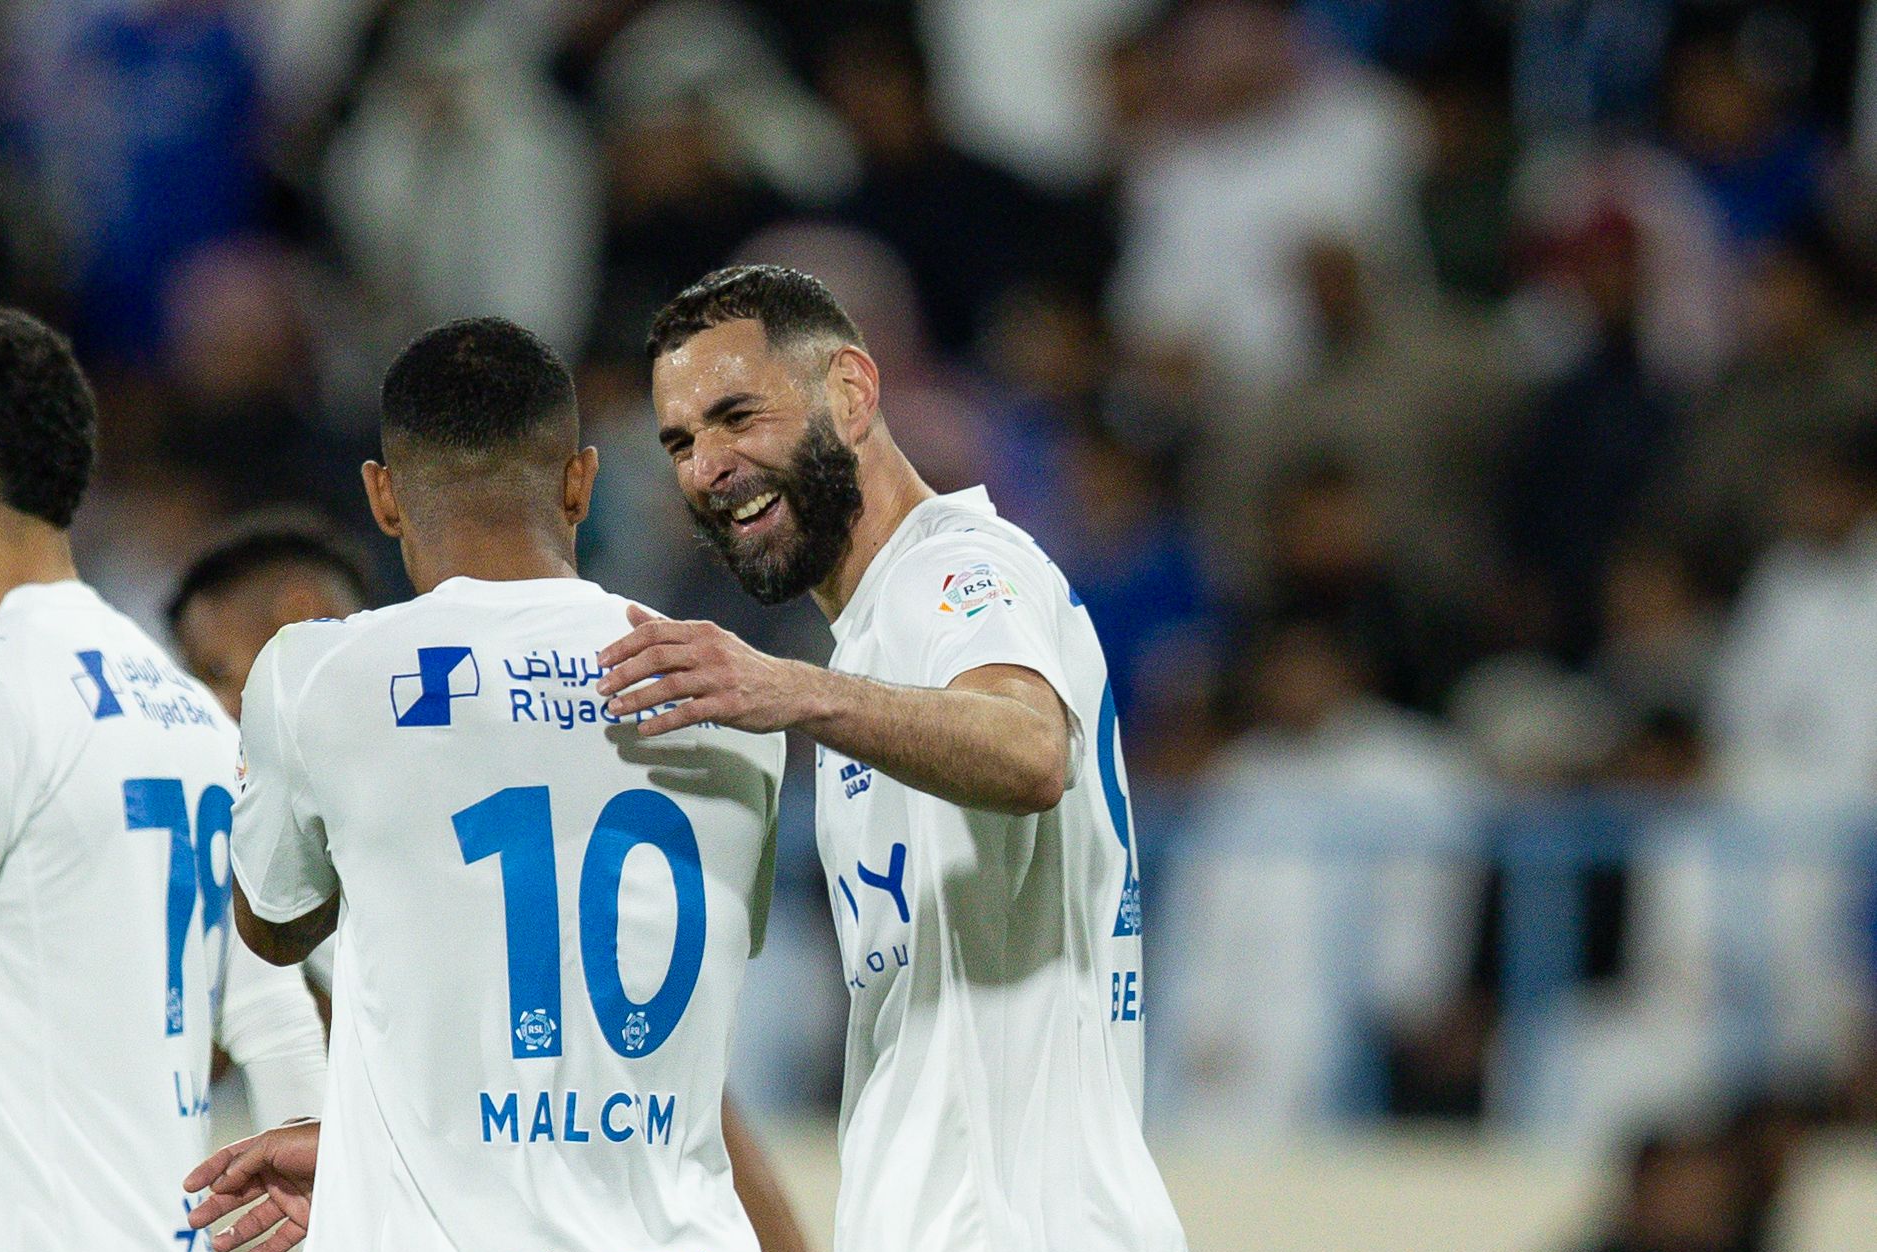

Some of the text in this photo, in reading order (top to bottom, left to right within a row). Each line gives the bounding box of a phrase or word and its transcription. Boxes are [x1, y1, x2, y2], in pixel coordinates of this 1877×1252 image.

[963, 579, 996, 596] RSL
[451, 786, 707, 1059] 10
[528, 1024, 544, 1035] RSL
[479, 1090, 676, 1145] MALCM
